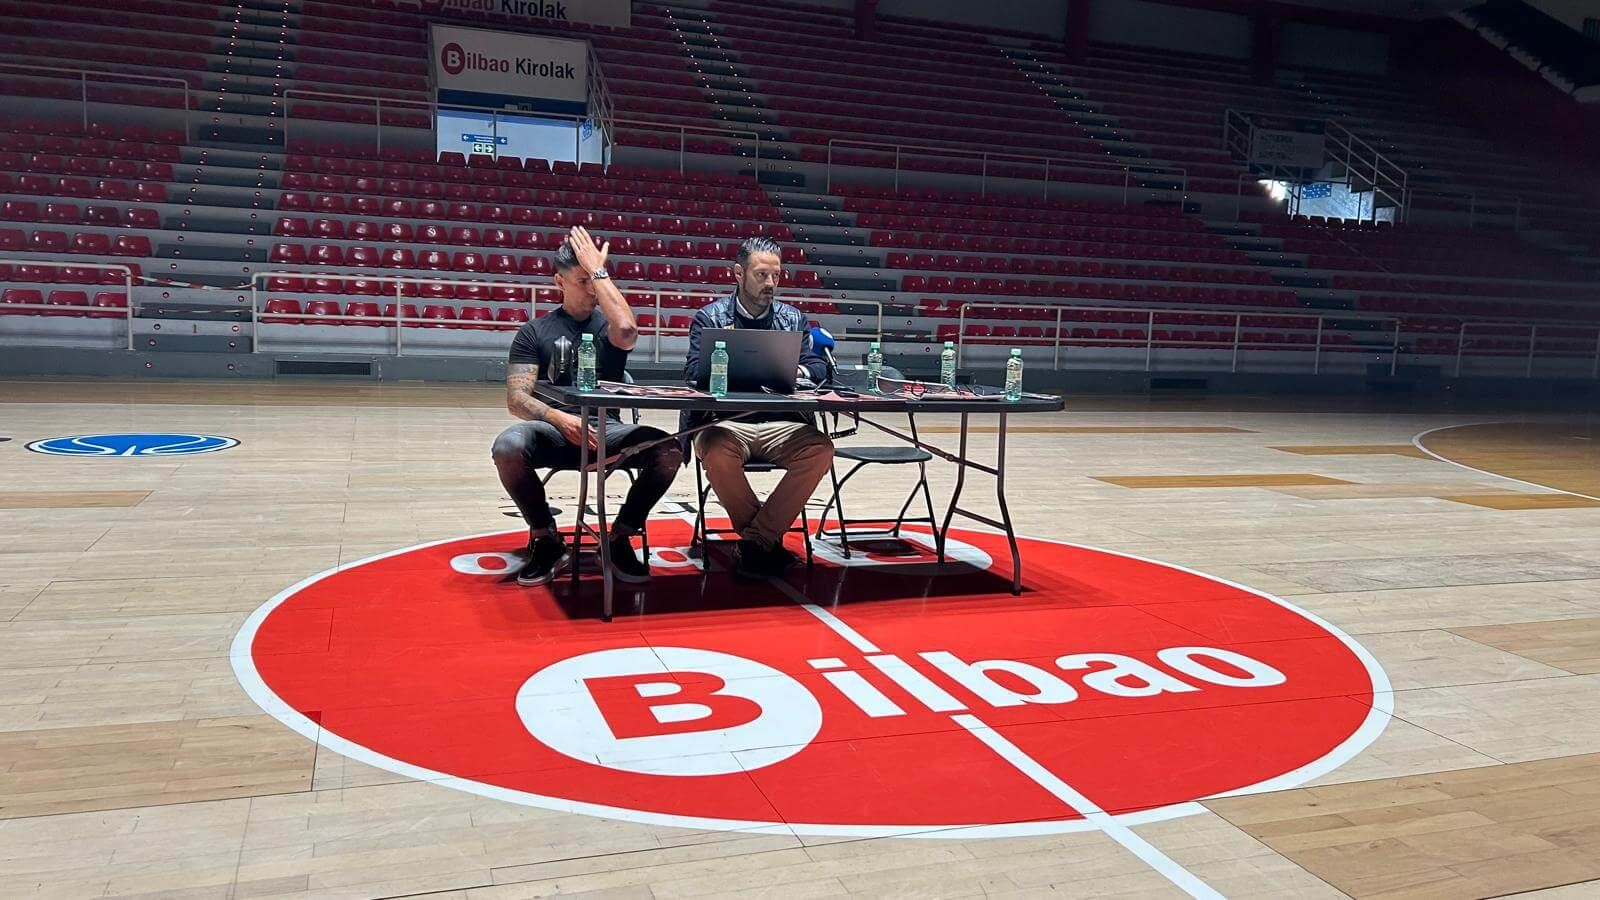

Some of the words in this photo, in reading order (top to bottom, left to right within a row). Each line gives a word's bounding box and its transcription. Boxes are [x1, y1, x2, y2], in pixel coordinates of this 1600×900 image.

[501, 0, 567, 20] Kirolak
[445, 46, 510, 74] Bilbao
[515, 57, 575, 80] Kirolak
[581, 646, 1288, 741] Bilbao
